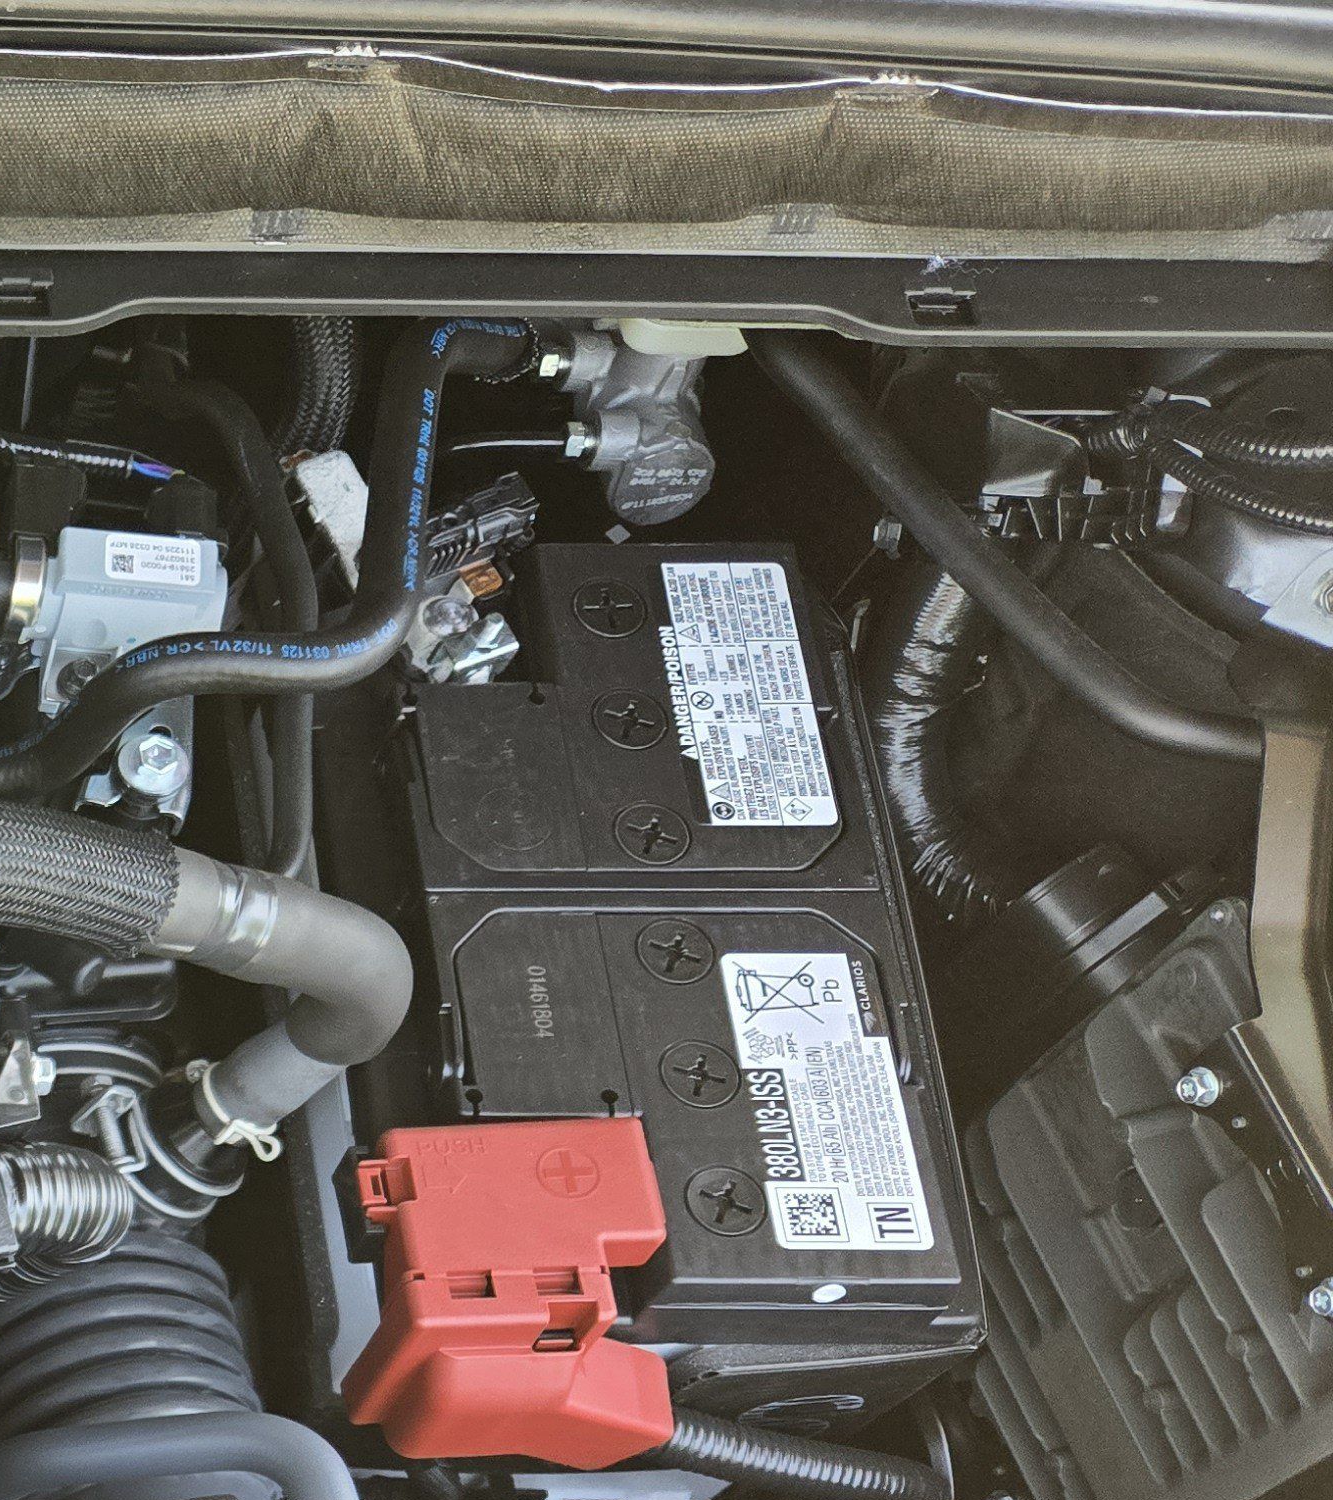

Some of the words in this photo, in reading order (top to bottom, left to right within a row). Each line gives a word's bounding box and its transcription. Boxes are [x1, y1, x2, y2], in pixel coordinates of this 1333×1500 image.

[659, 626, 696, 745] DANGER/POISON
[819, 979, 842, 1002] Pb
[850, 960, 871, 1010] CLARIOS
[784, 1032, 799, 1059] >PP<
[803, 1046, 827, 1065] (EN)
[808, 1068, 825, 1077] A
[811, 1080, 830, 1096] 603
[815, 1100, 835, 1120] CCA
[750, 1070, 803, 1178] 380LN3-ISS
[821, 1126, 839, 1139] Ah
[824, 1142, 842, 1153] 65
[828, 1157, 846, 1168] Hr
[830, 1170, 849, 1182] 20
[873, 1207, 915, 1238] TN
